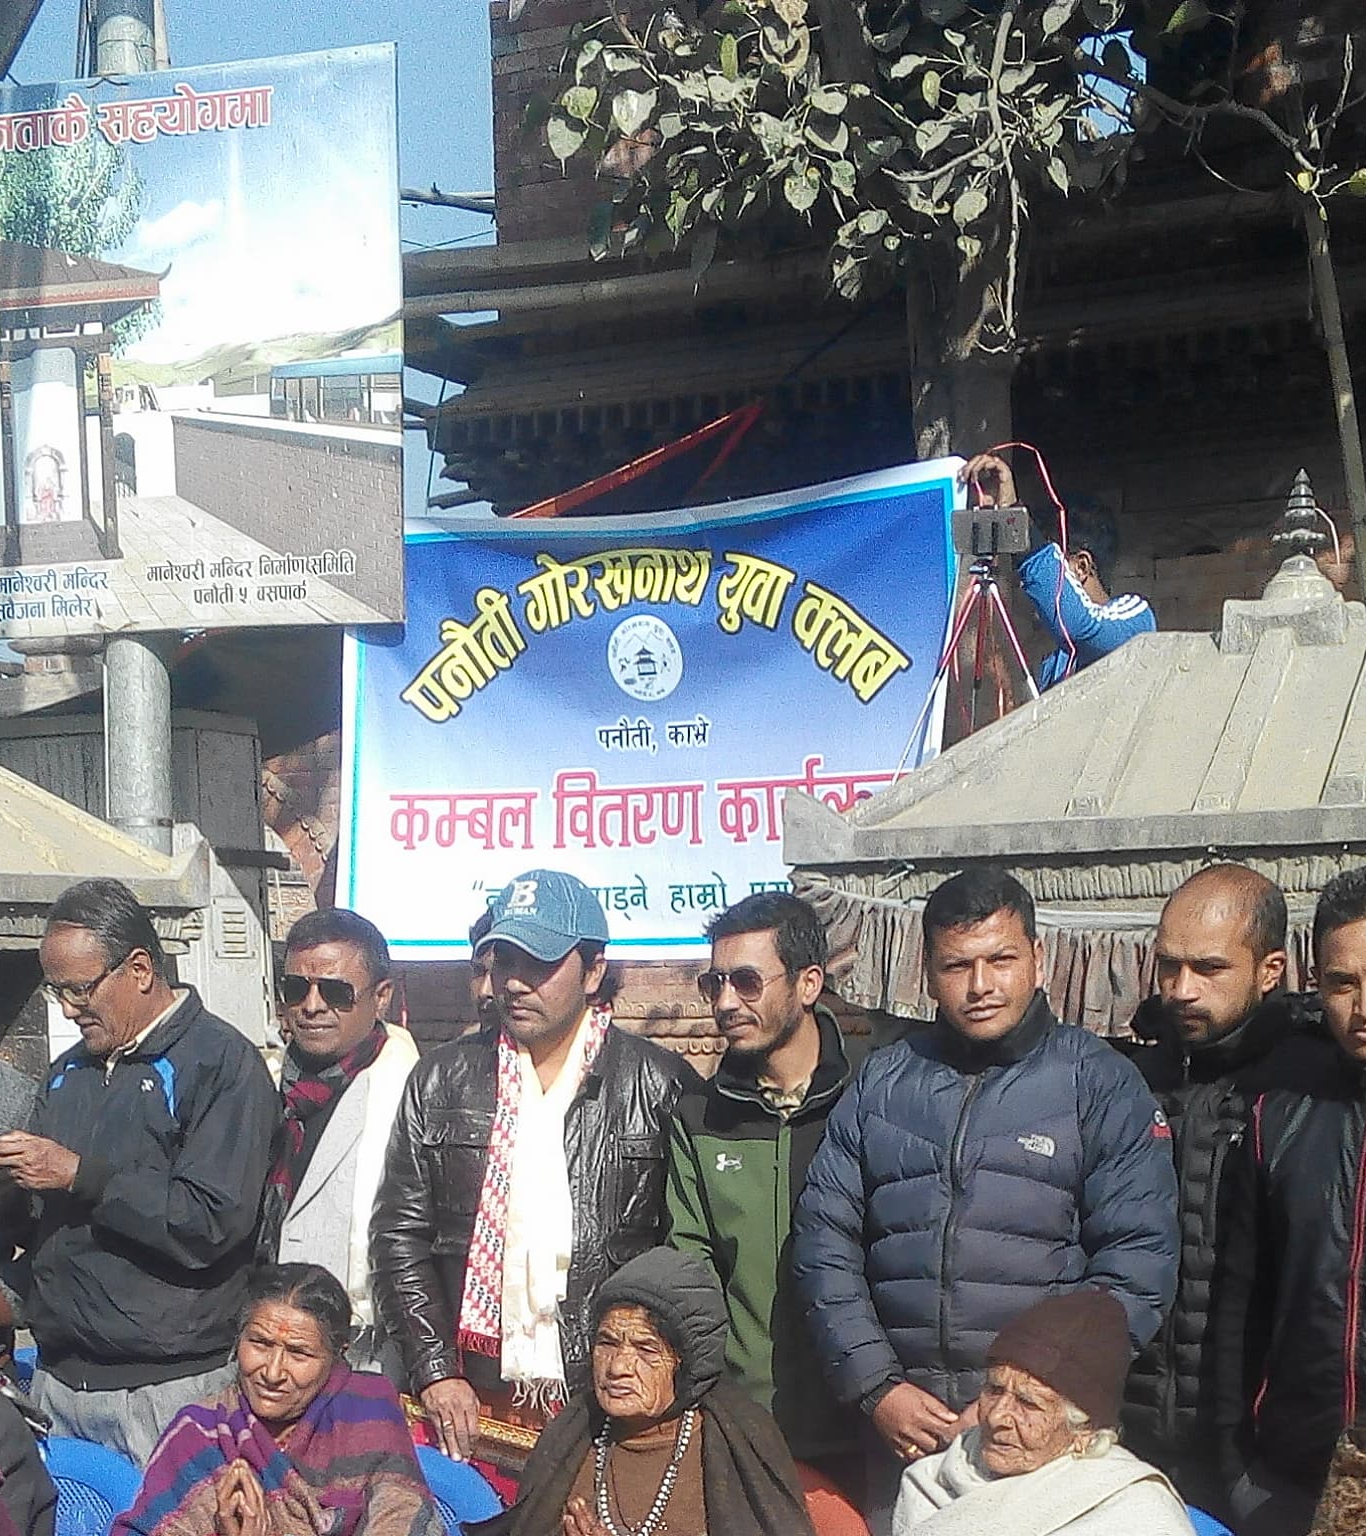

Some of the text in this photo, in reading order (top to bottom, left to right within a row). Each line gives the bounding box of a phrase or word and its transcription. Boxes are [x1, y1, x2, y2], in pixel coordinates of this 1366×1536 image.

[98, 84, 274, 145] सहयोगमा
[63, 570, 109, 593] मन्दिर
[147, 558, 204, 583] मानेश्वरी
[210, 556, 254, 579] मन्दिर
[193, 583, 235, 605] पनौती
[400, 583, 528, 725] पनौती
[518, 547, 711, 633] गोरखनाथ
[716, 550, 795, 635] युवा
[790, 580, 913, 705] क्लब
[597, 713, 709, 753] पनौती, काभ्रे
[389, 788, 538, 851] कम्बल
[552, 770, 705, 850] वितरण
[669, 870, 727, 914] हाम्रो
